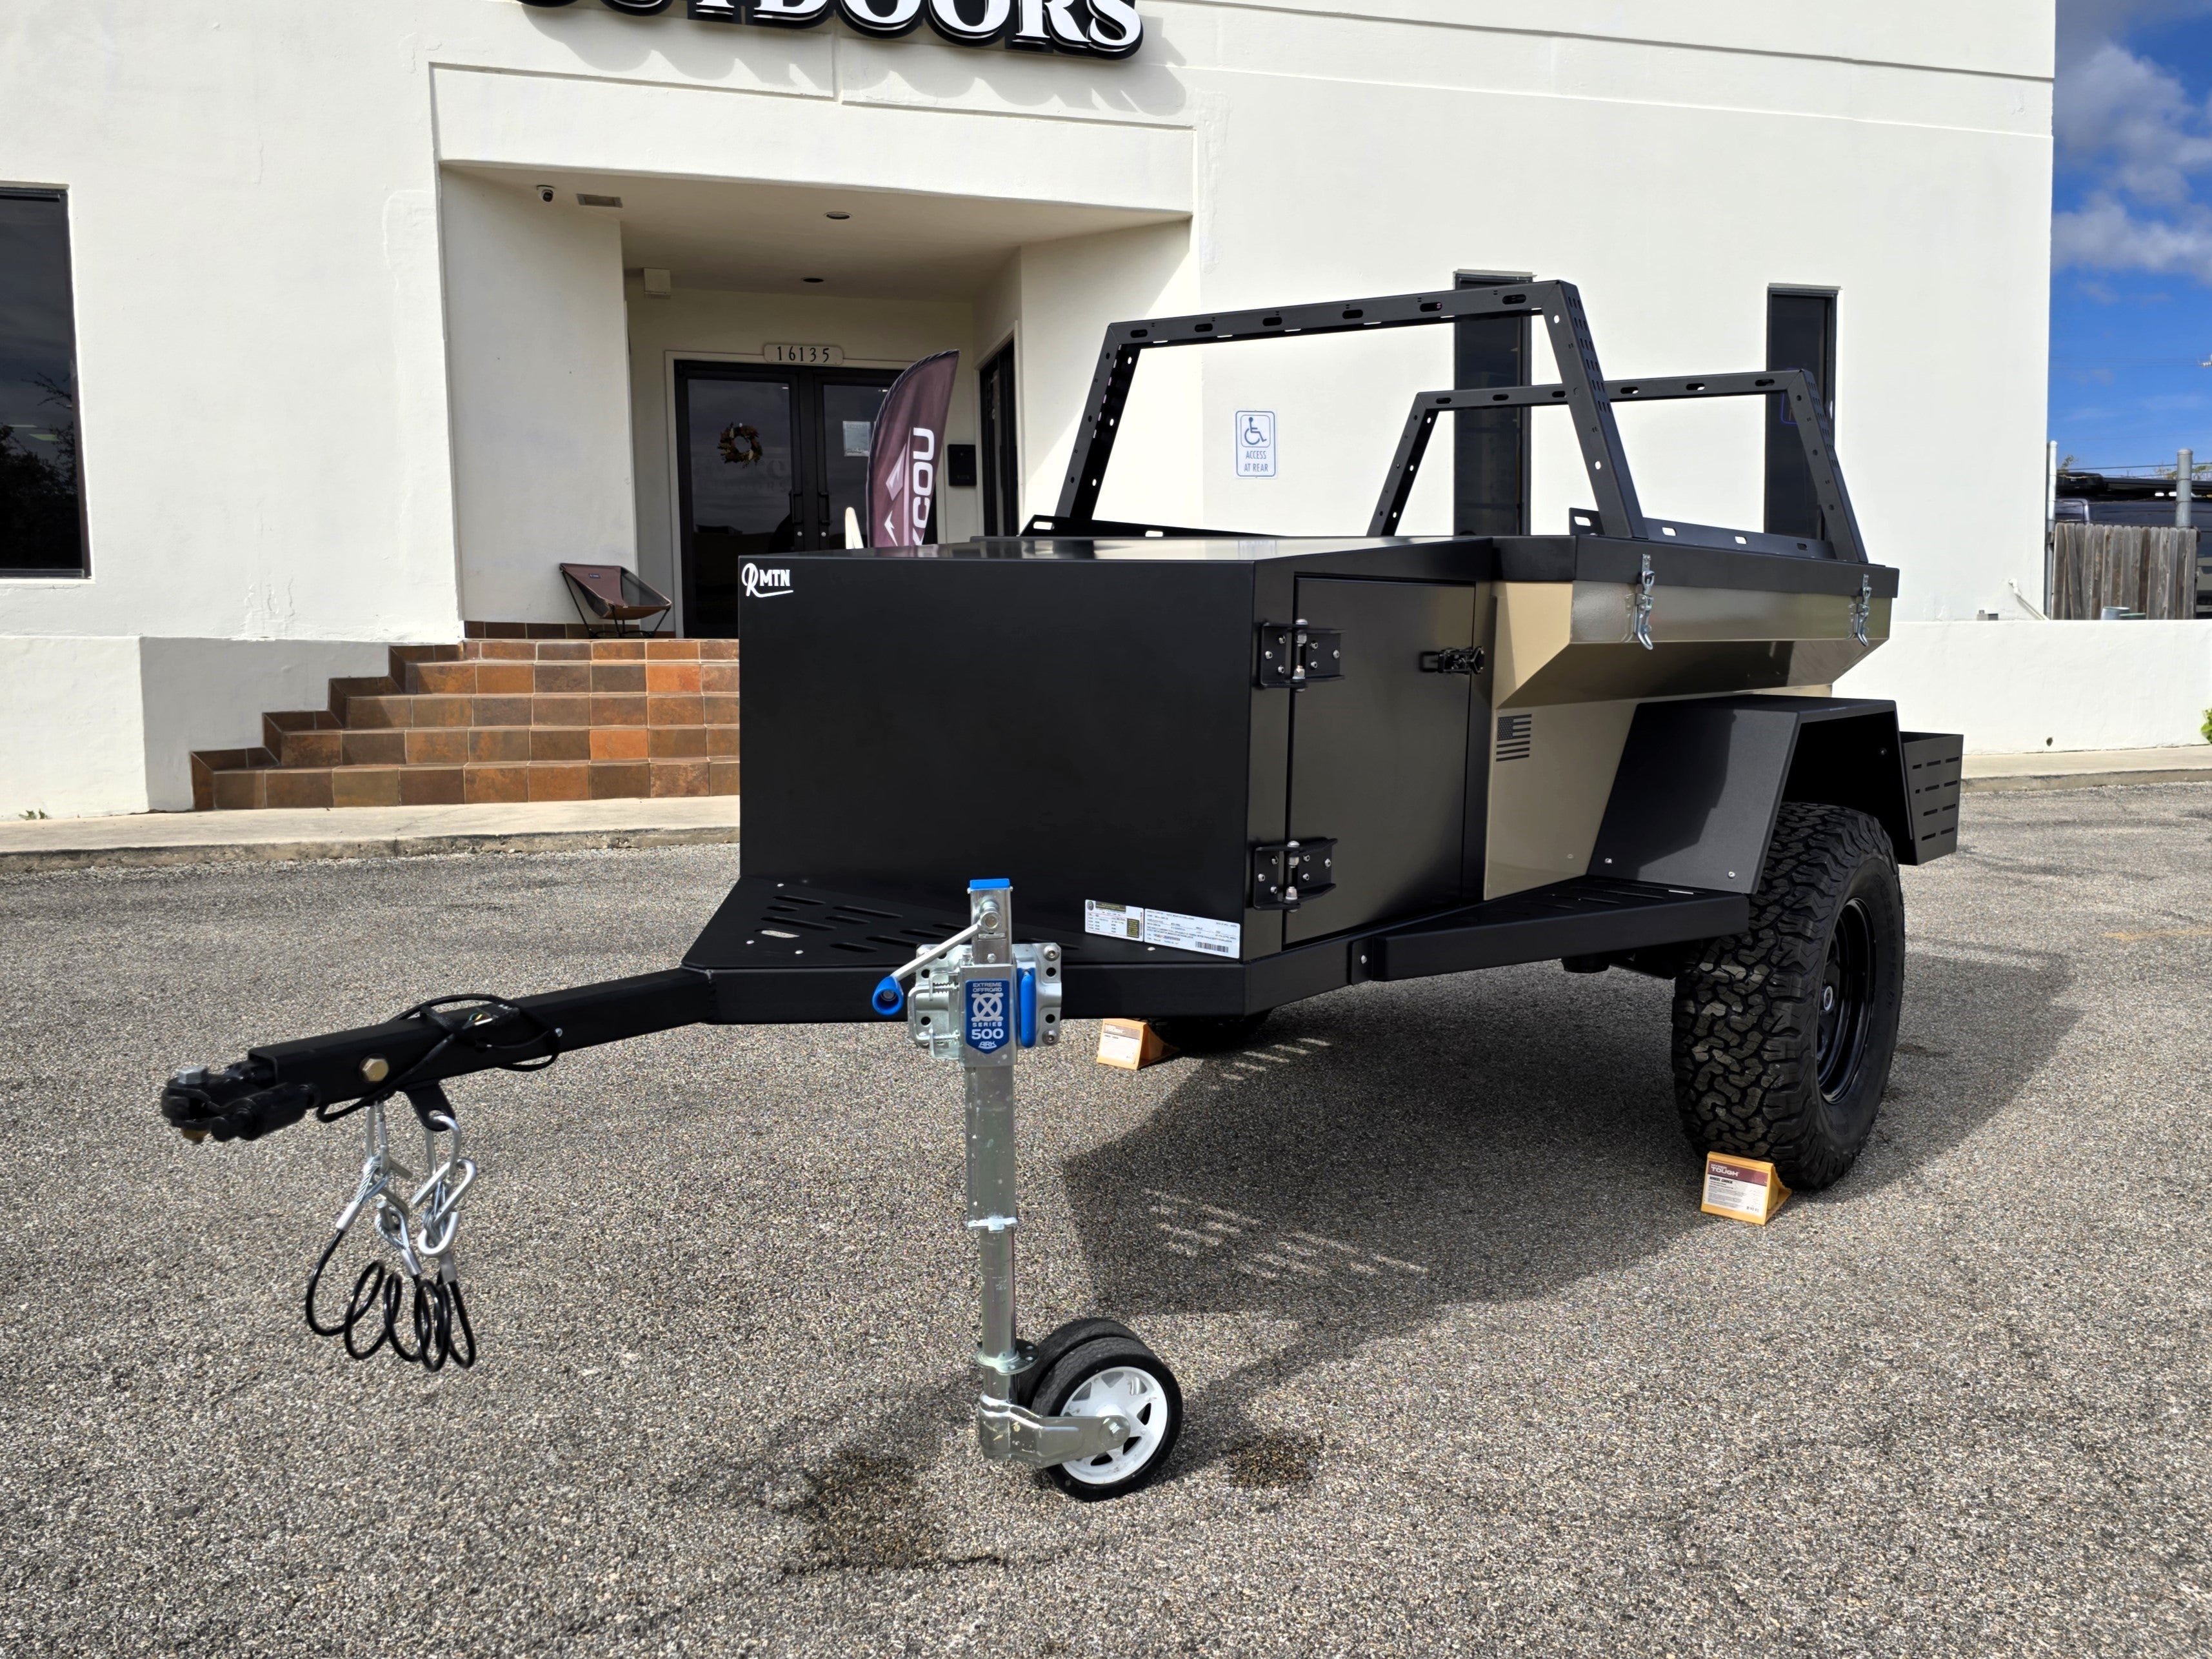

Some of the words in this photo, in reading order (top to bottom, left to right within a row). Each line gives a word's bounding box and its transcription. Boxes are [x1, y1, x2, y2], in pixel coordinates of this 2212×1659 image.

[777, 346, 830, 363] 16135
[1246, 450, 1267, 459] ACCESS
[1244, 463, 1251, 472] AT
[1253, 463, 1269, 472] REAR
[971, 1028, 1004, 1040] 500
[979, 1040, 997, 1050] ARK
[1711, 1166, 1739, 1177] TOUGH
